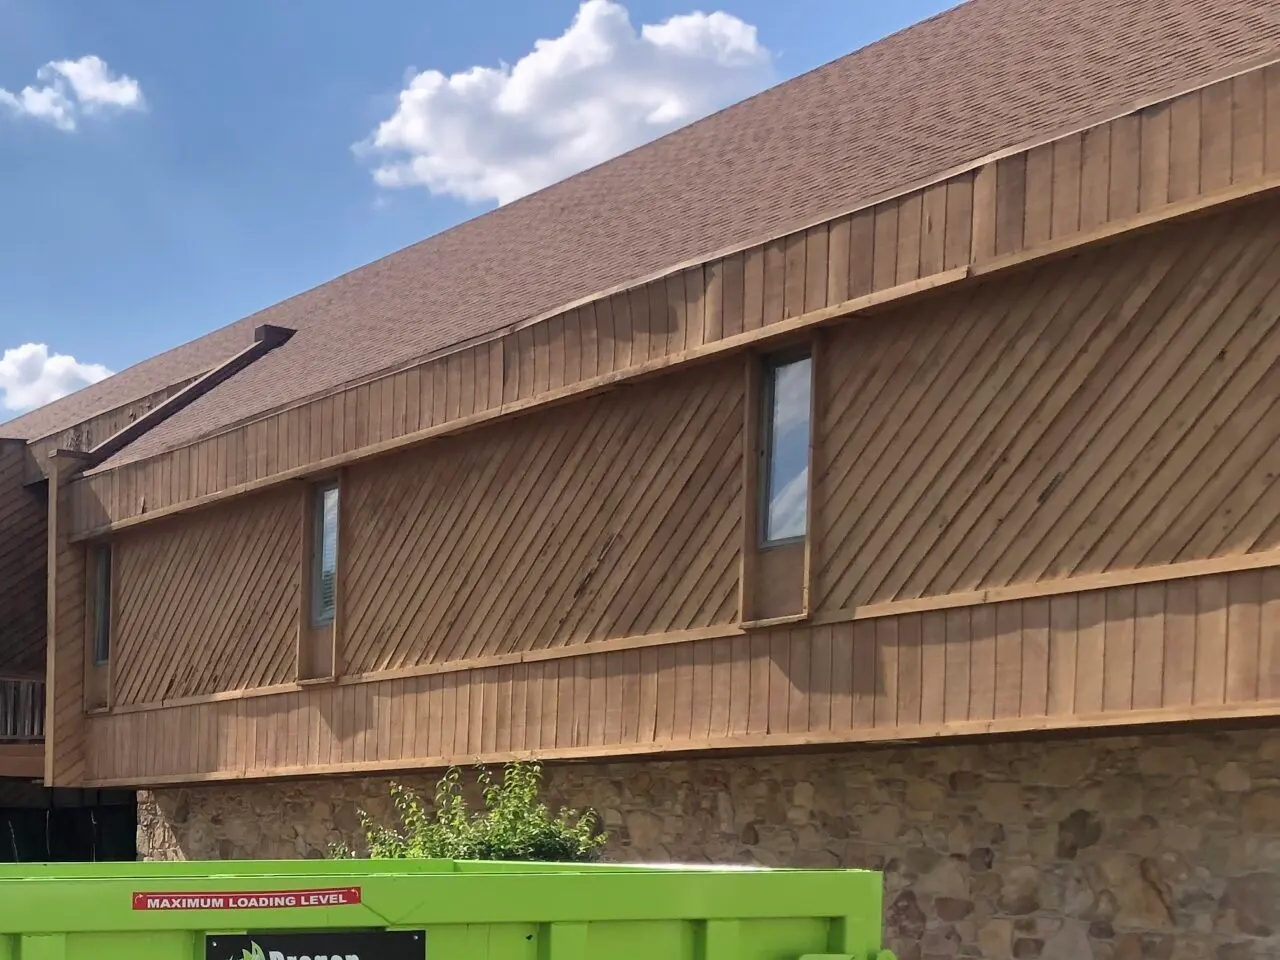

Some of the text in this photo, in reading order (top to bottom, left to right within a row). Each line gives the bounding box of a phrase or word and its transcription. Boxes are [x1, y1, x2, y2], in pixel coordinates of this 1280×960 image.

[146, 893, 347, 909] MAXIMUM LOADING LEVEL
